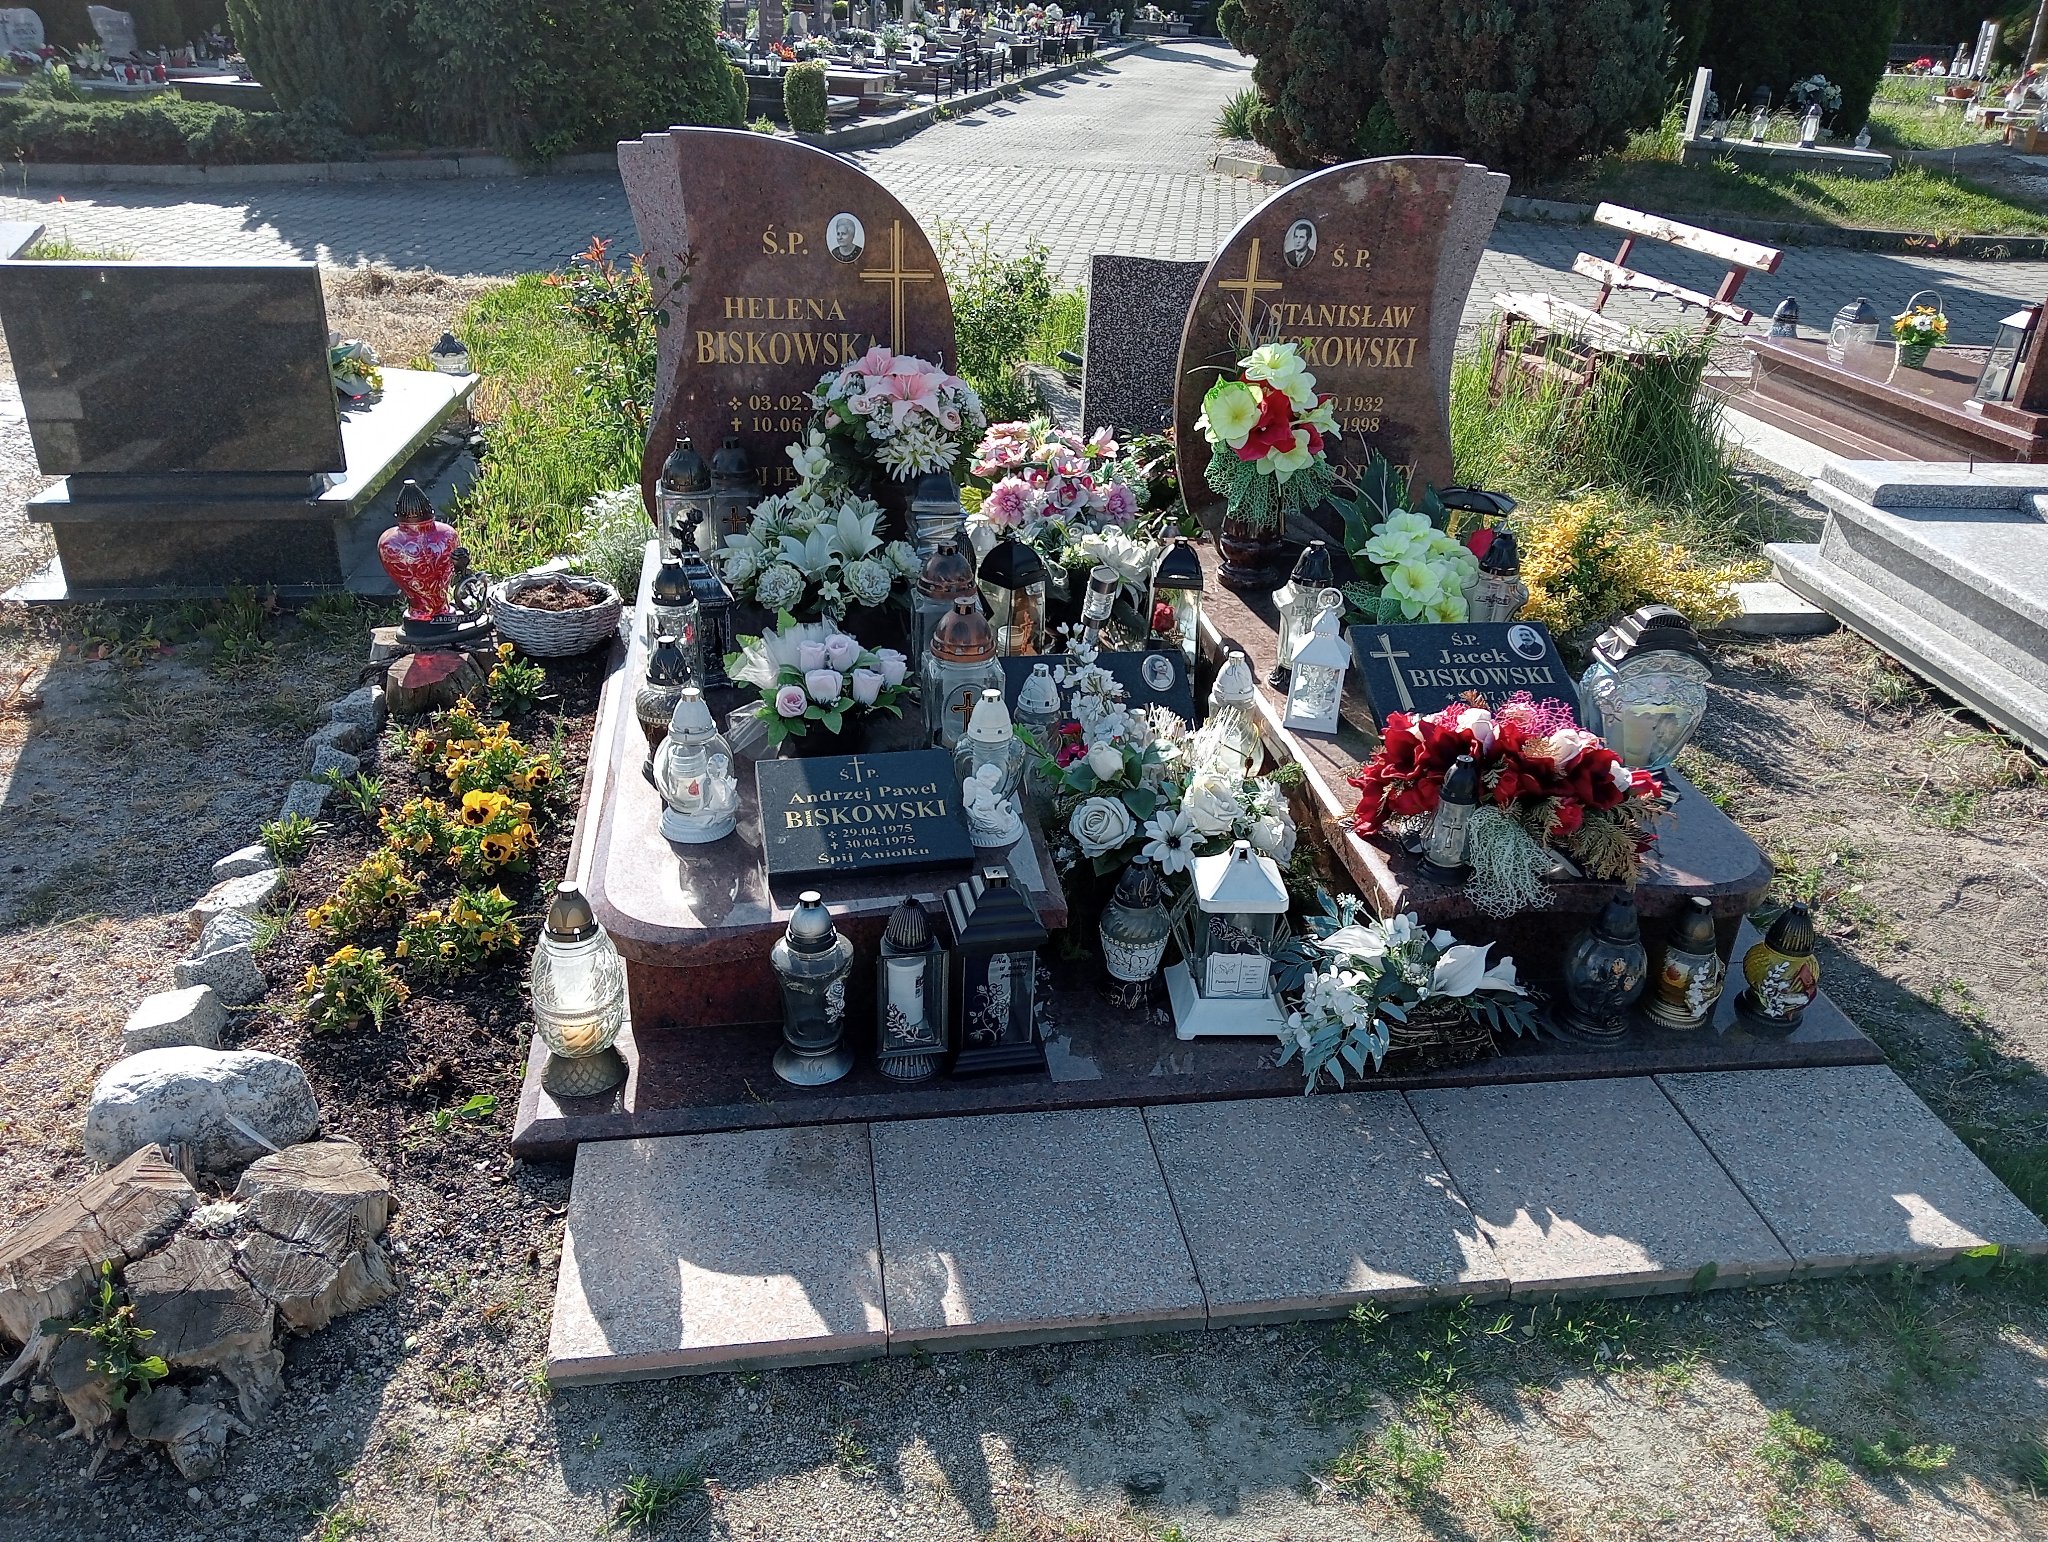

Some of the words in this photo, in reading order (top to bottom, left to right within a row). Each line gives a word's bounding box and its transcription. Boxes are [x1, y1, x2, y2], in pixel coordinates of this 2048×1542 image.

[762, 224, 809, 255] Ś.P.
[723, 296, 846, 321] HELENA
[1269, 303, 1416, 328] STANISŁAW
[1258, 335, 1419, 369] KOWSKI
[1341, 417, 1380, 433] 1998
[1439, 648, 1511, 665] Jacek
[1407, 666, 1556, 688] BISKOWSKI
[789, 787, 871, 805] Andrzej
[784, 799, 947, 829] BISKOWSKI
[842, 824, 913, 838] 29.04.1975
[845, 835, 916, 849] 30.04.1975
